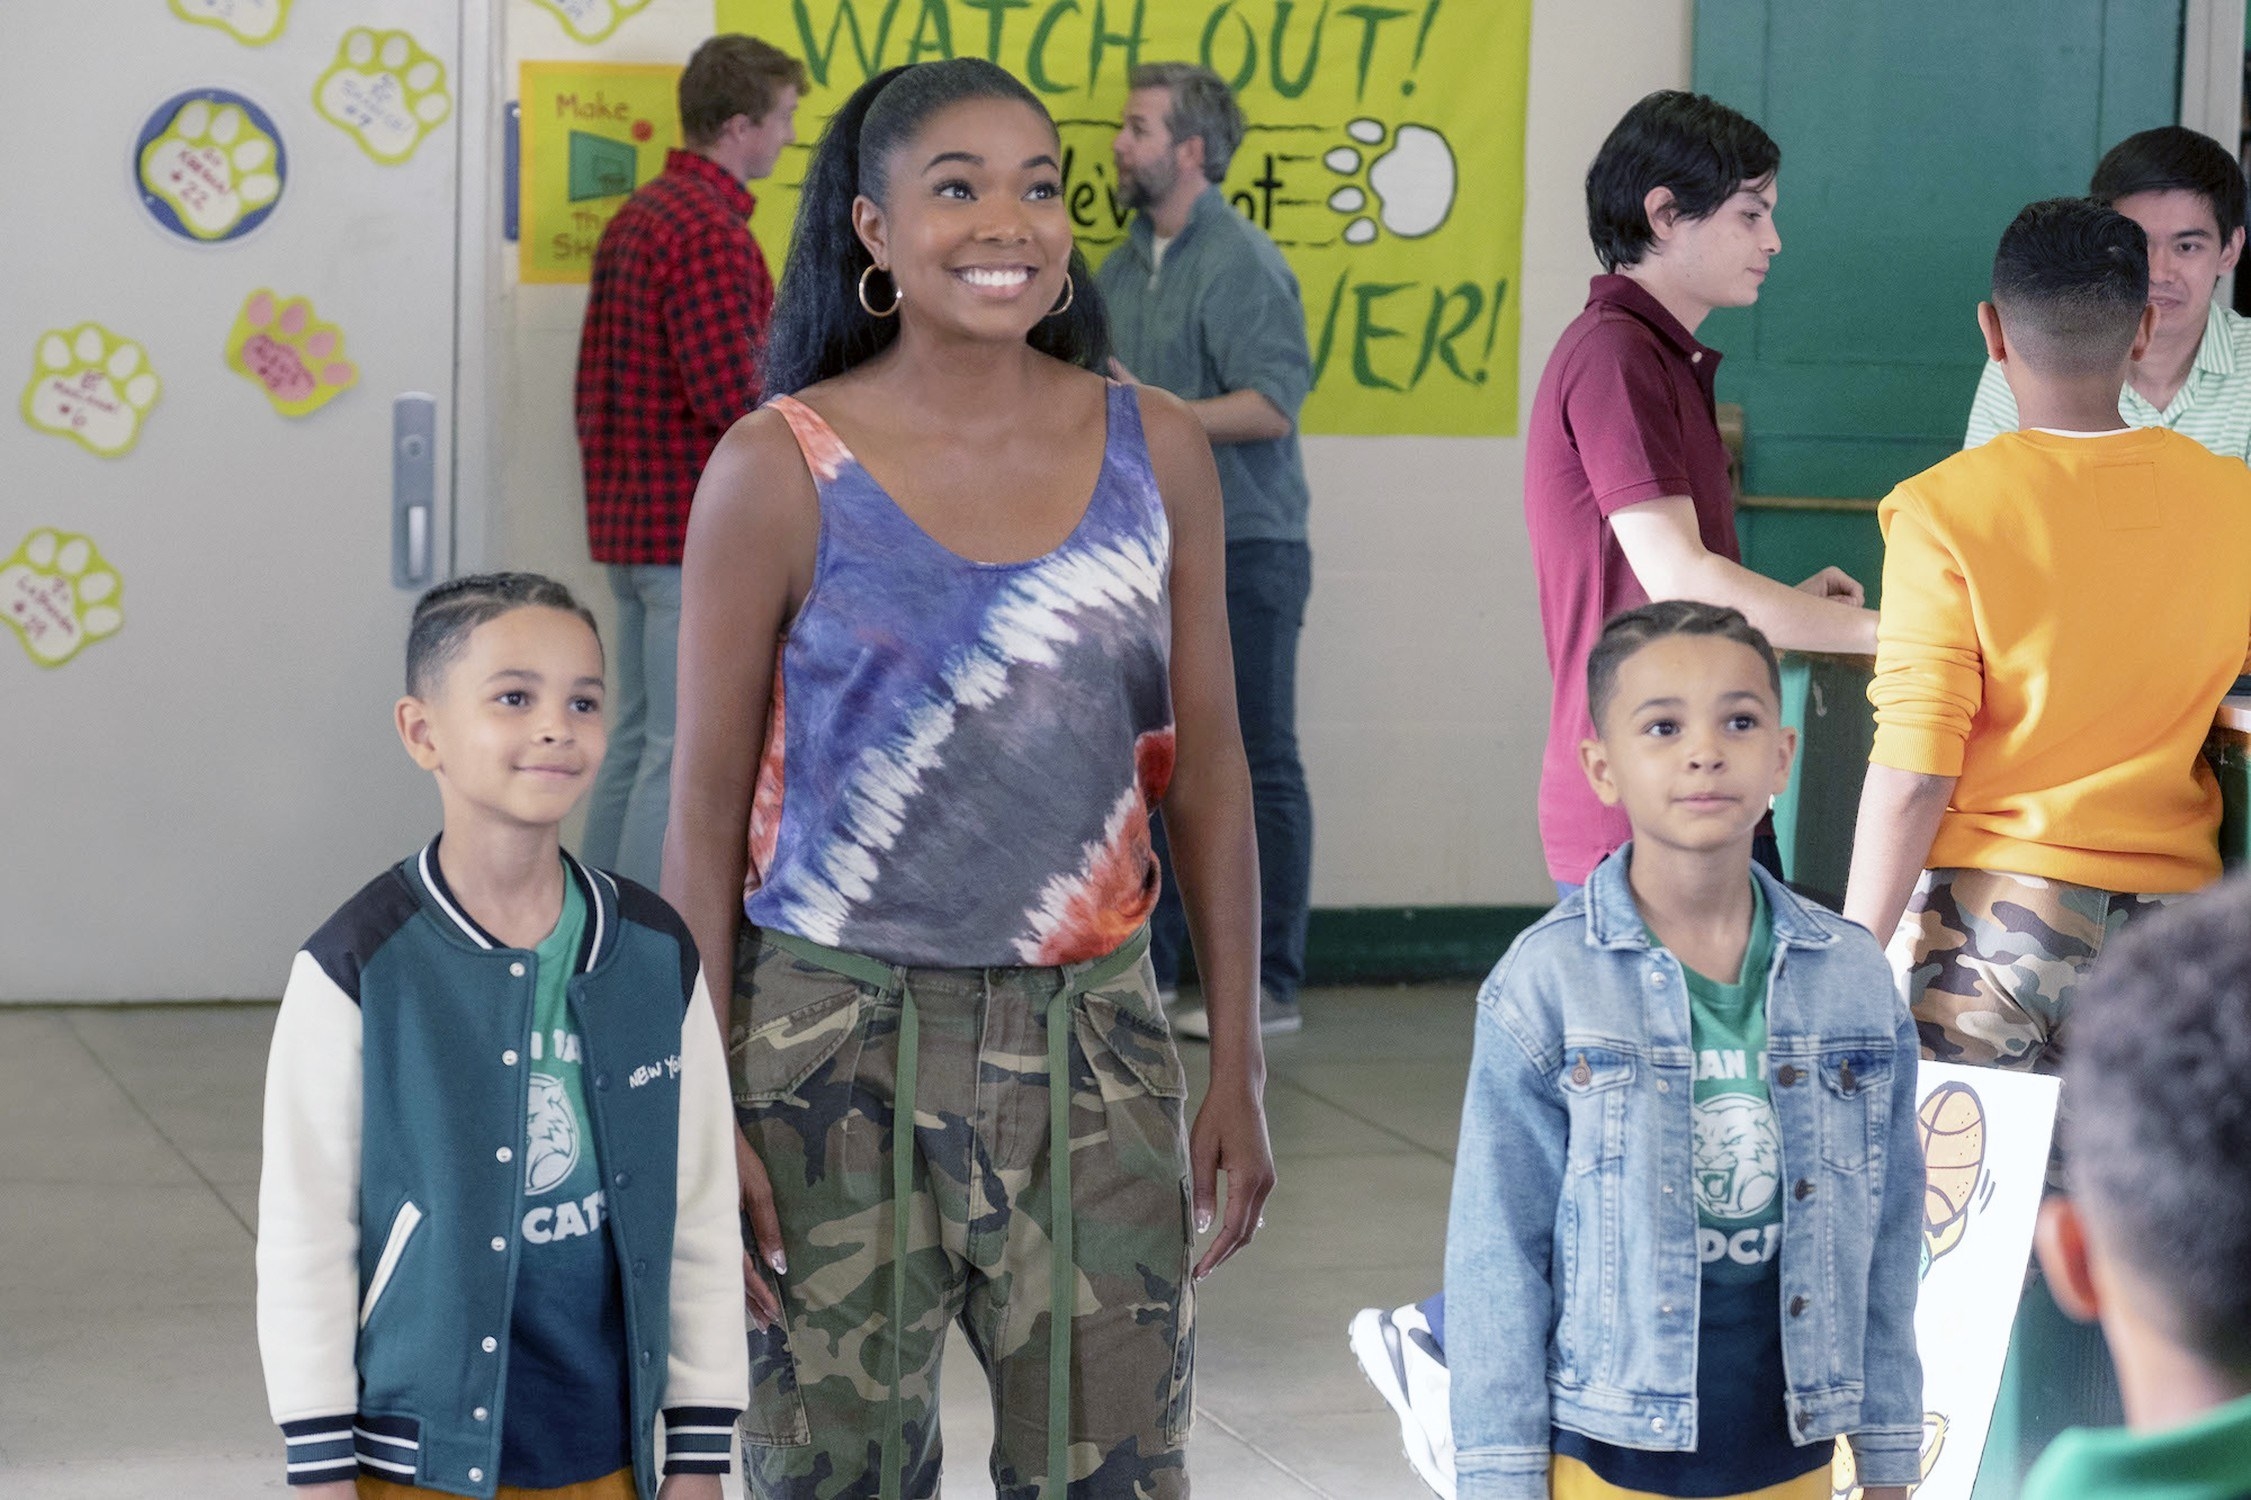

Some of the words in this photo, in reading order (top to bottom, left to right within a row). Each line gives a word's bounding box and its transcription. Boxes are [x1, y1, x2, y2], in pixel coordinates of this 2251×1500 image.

[792, 0, 1150, 98] WATCH
[1200, 0, 1440, 103] OUT!
[556, 90, 630, 121] Make
[1232, 153, 1283, 230] ot
[572, 211, 601, 231] Th
[552, 232, 596, 260] SH
[629, 1061, 663, 1089] NEW
[663, 1054, 682, 1079] YO
[1699, 1048, 1747, 1080] AN
[521, 1190, 605, 1245] CAT
